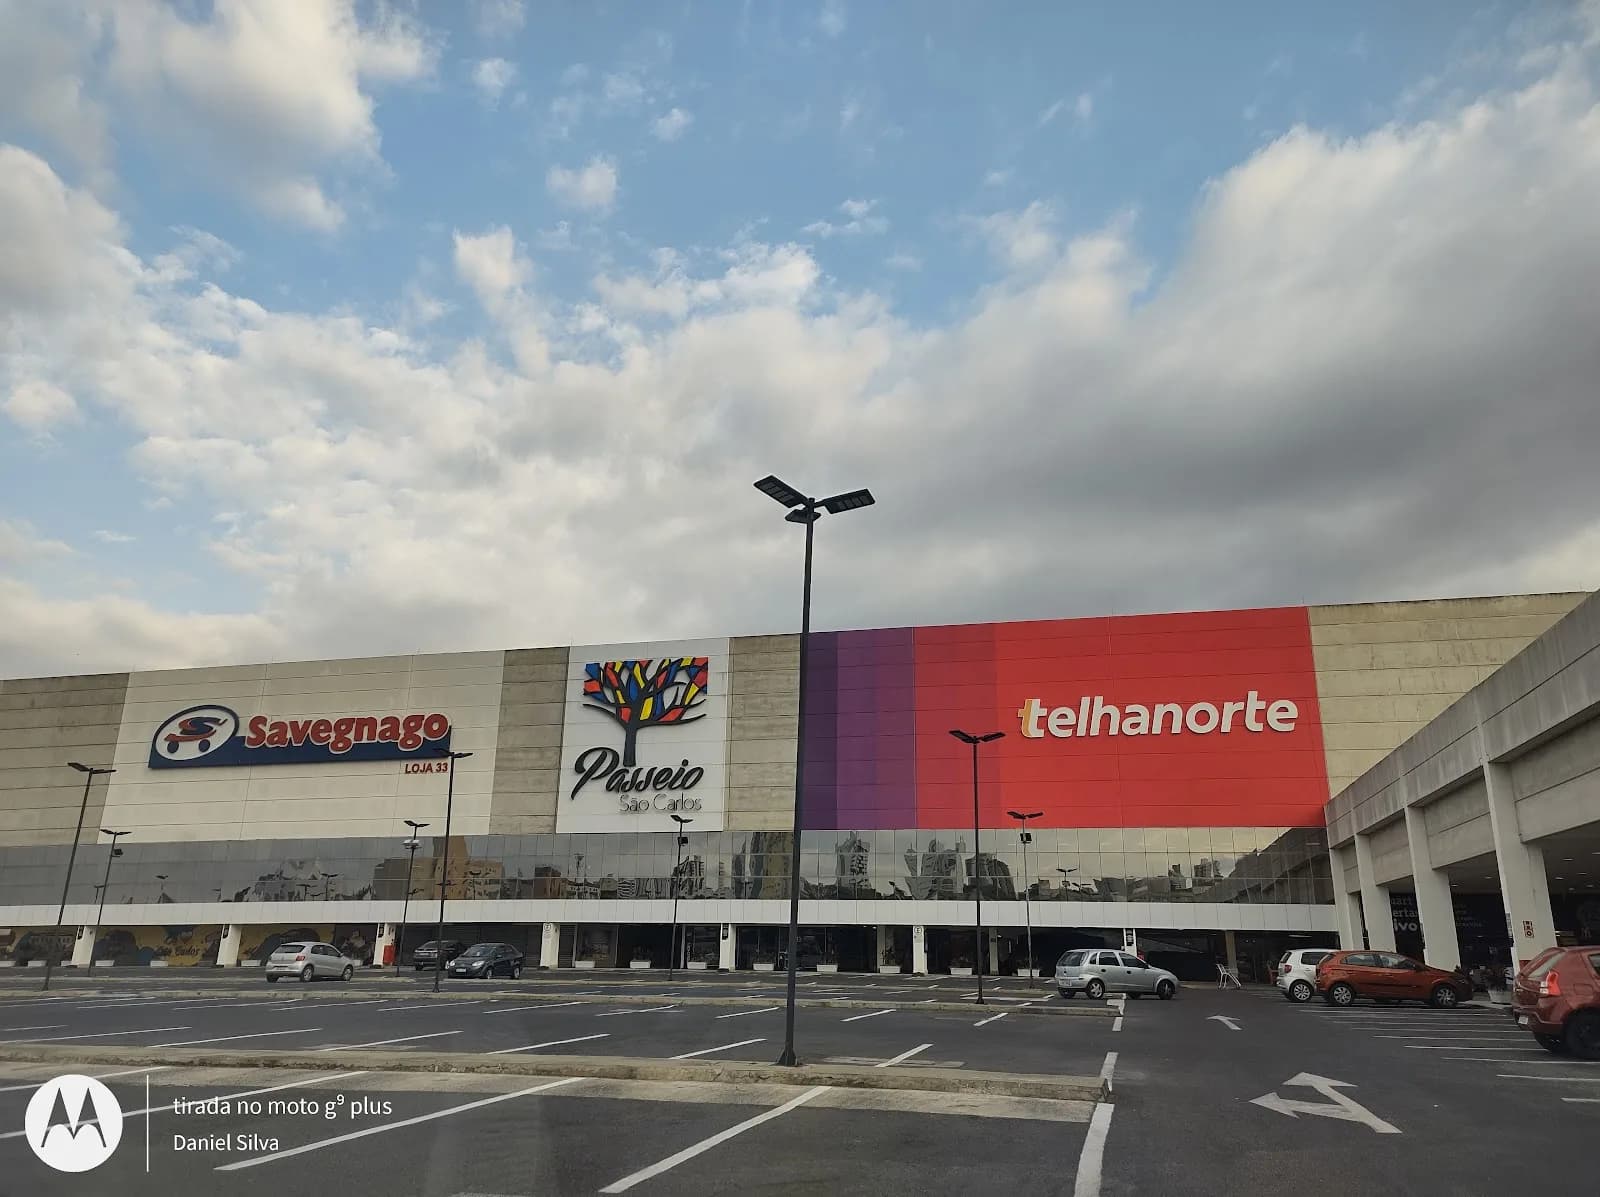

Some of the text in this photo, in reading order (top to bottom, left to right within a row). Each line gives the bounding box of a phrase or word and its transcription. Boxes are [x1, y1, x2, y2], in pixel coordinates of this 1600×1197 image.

[245, 713, 449, 753] Savegnago
[1017, 690, 1299, 738] telhanorte
[404, 762, 449, 775] LOJA 33
[571, 747, 703, 800] Passeio
[619, 792, 702, 811] São Carlos
